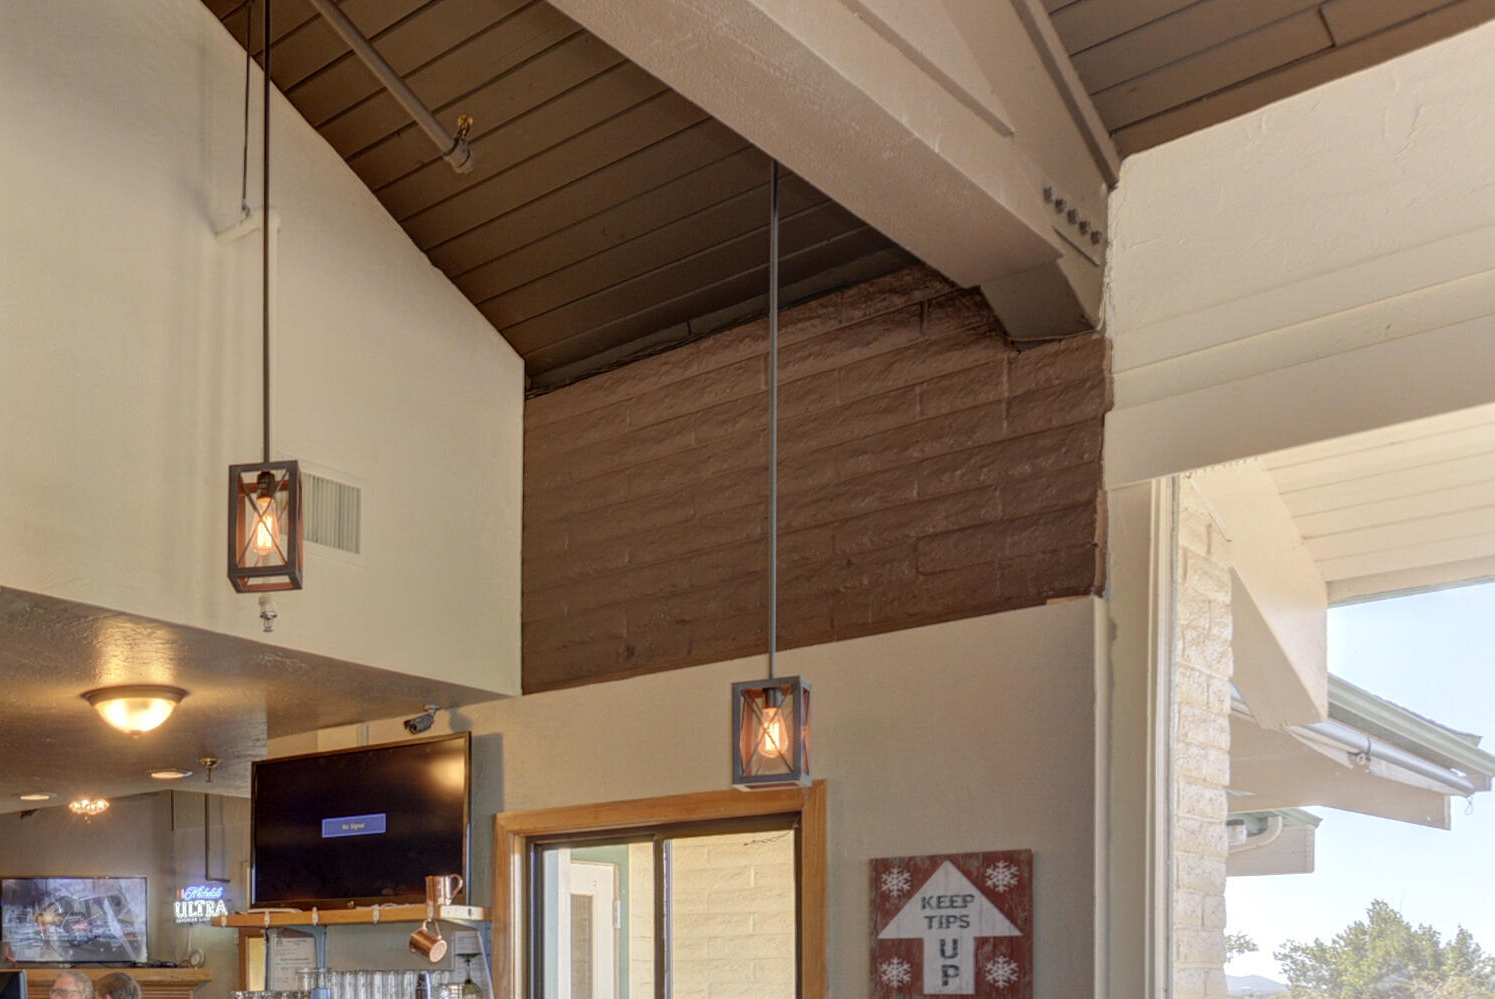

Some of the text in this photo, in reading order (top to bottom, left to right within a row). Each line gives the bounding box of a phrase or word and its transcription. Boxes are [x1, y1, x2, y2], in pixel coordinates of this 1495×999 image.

[174, 899, 229, 918] ULTRA
[920, 894, 976, 910] KEEP
[923, 914, 971, 930] TIPS
